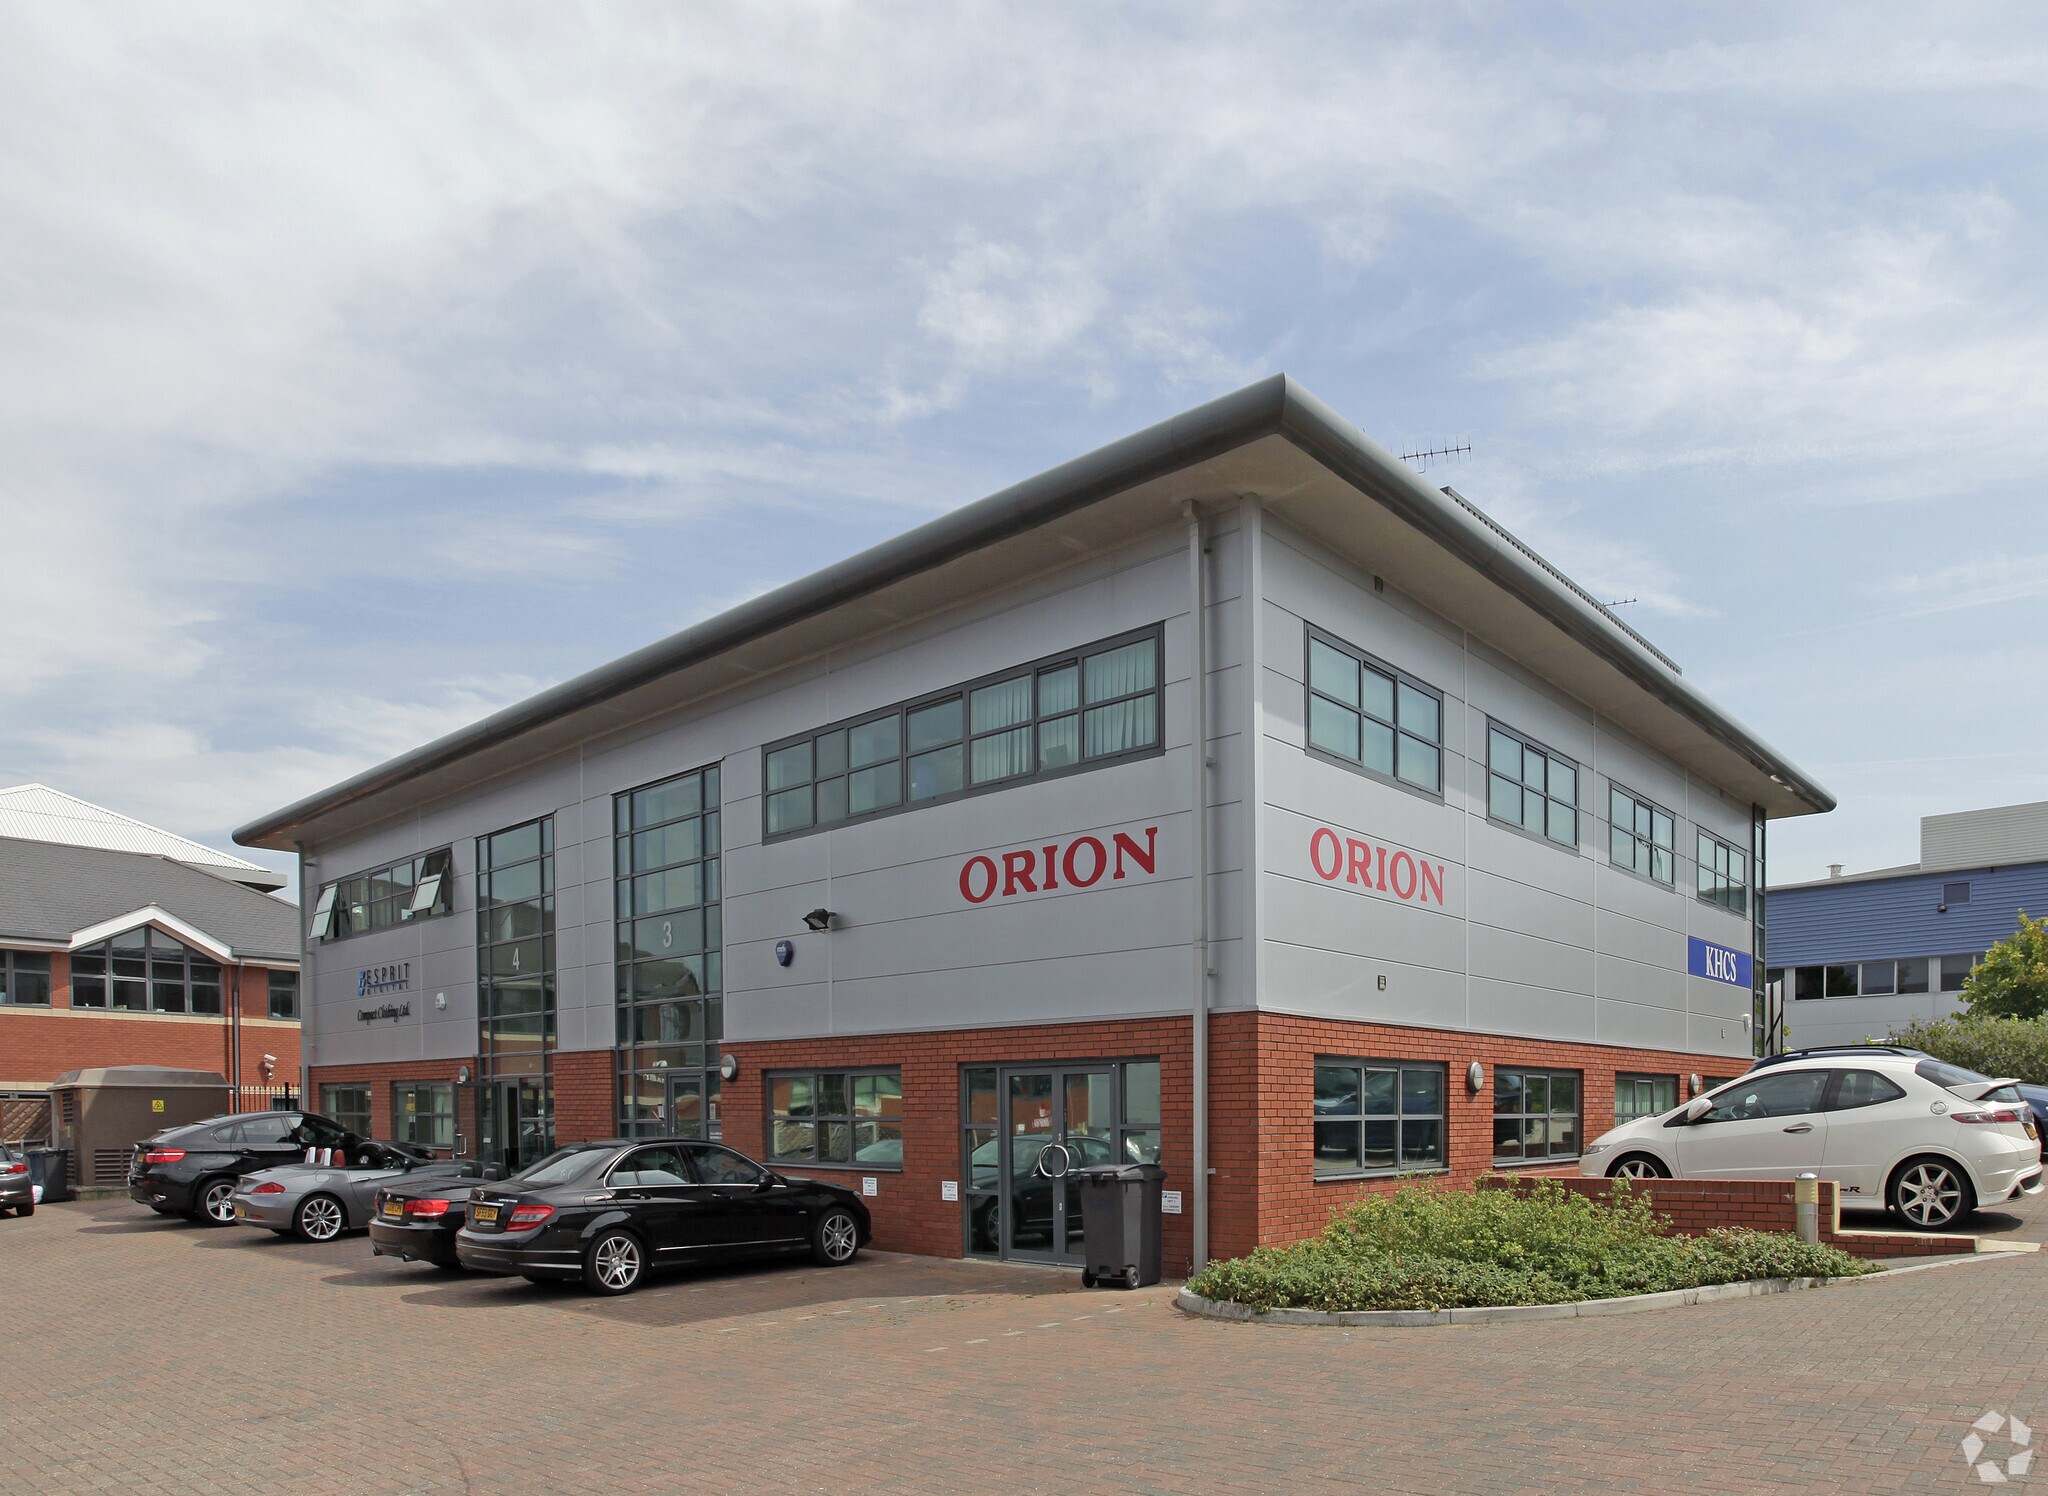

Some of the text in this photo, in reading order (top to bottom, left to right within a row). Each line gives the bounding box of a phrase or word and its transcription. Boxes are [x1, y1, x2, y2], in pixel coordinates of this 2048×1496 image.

[959, 826, 1158, 903] ORION
[1310, 827, 1445, 906] ORION
[663, 920, 672, 948] 3
[366, 962, 409, 985] ESPRIT
[512, 947, 520, 971] 4
[1705, 945, 1737, 982] KHCS
